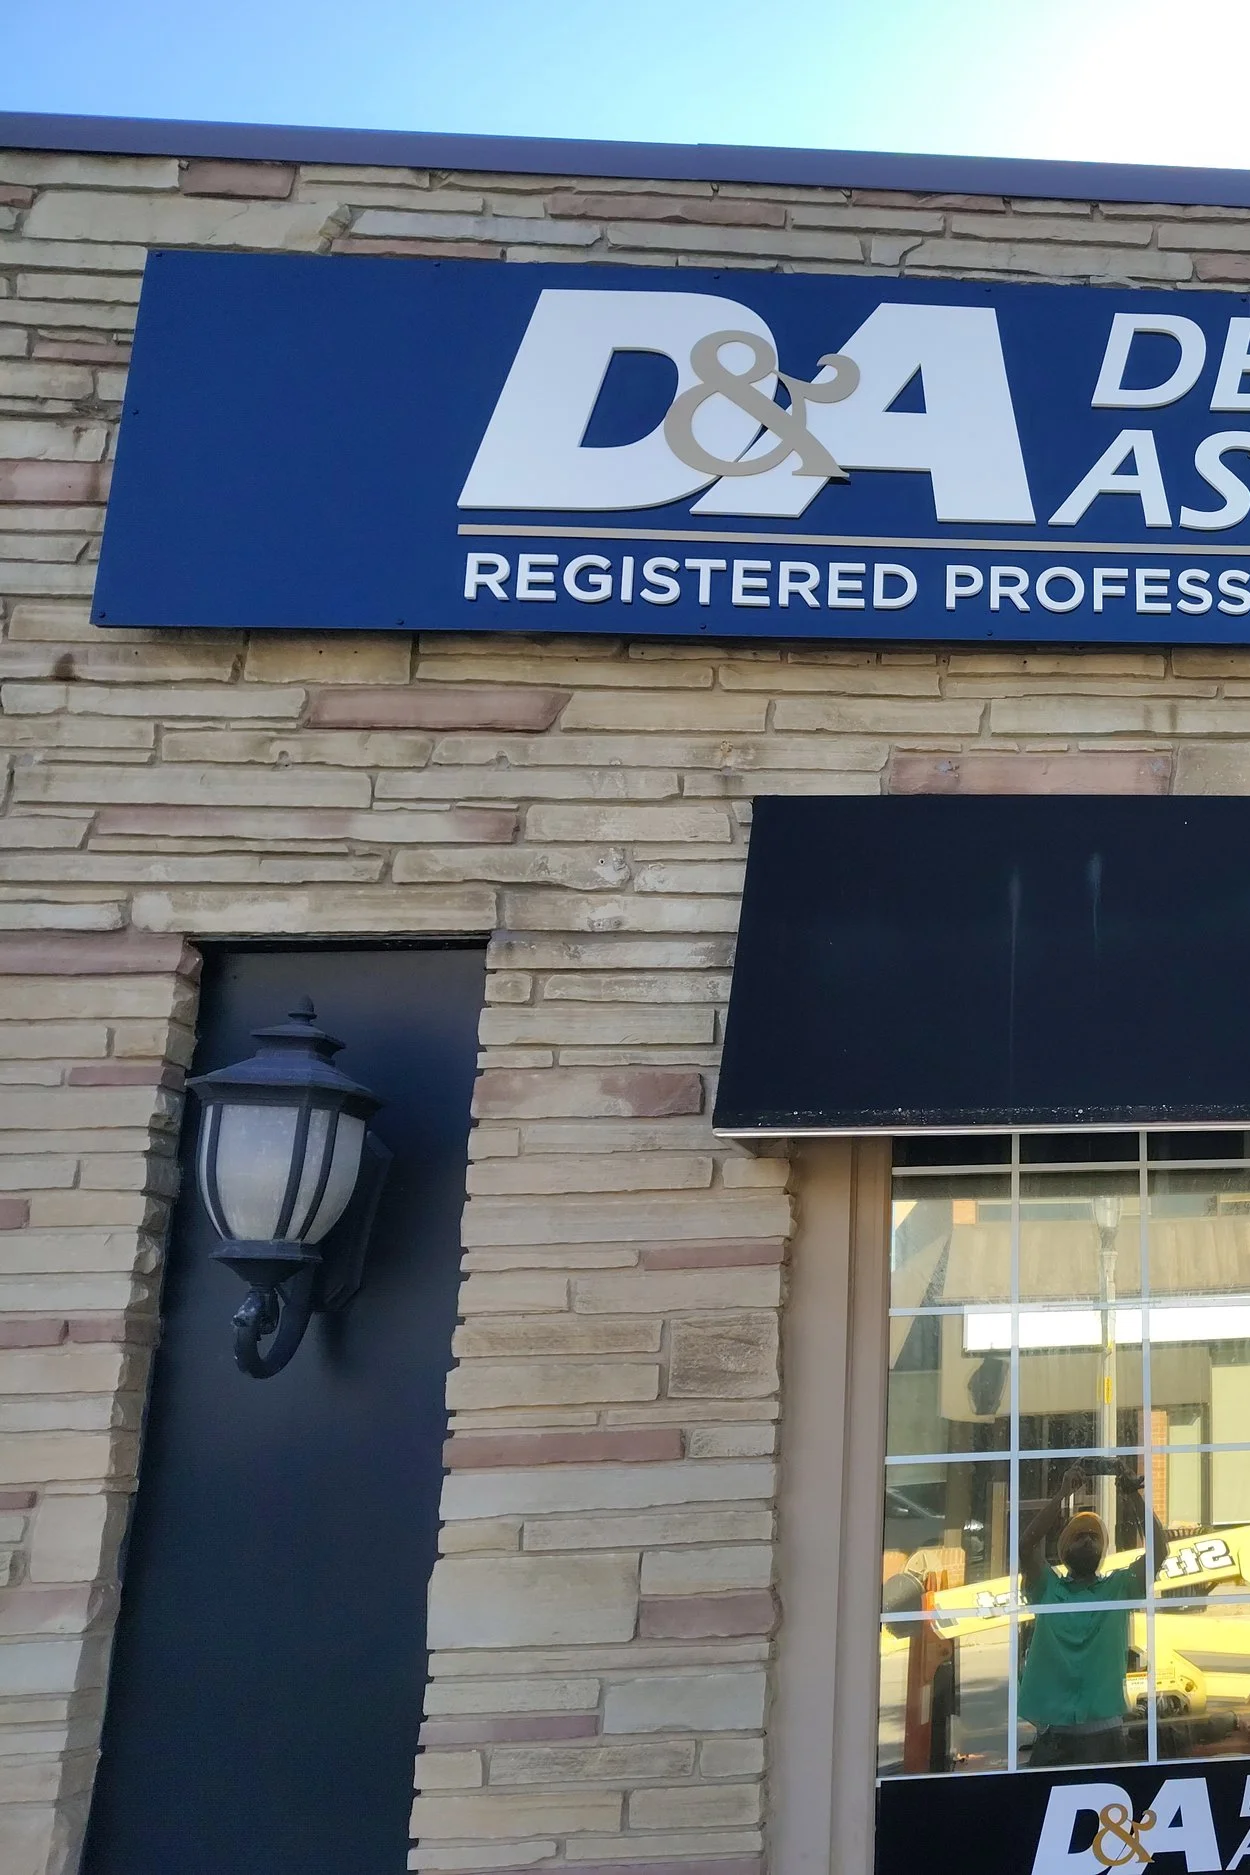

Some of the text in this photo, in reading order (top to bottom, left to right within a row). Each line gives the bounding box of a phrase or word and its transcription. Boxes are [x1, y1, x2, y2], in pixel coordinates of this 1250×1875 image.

[457, 288, 1037, 525] D&A
[463, 552, 918, 610] REGISTERED
[1031, 1777, 1224, 1875] D&A
